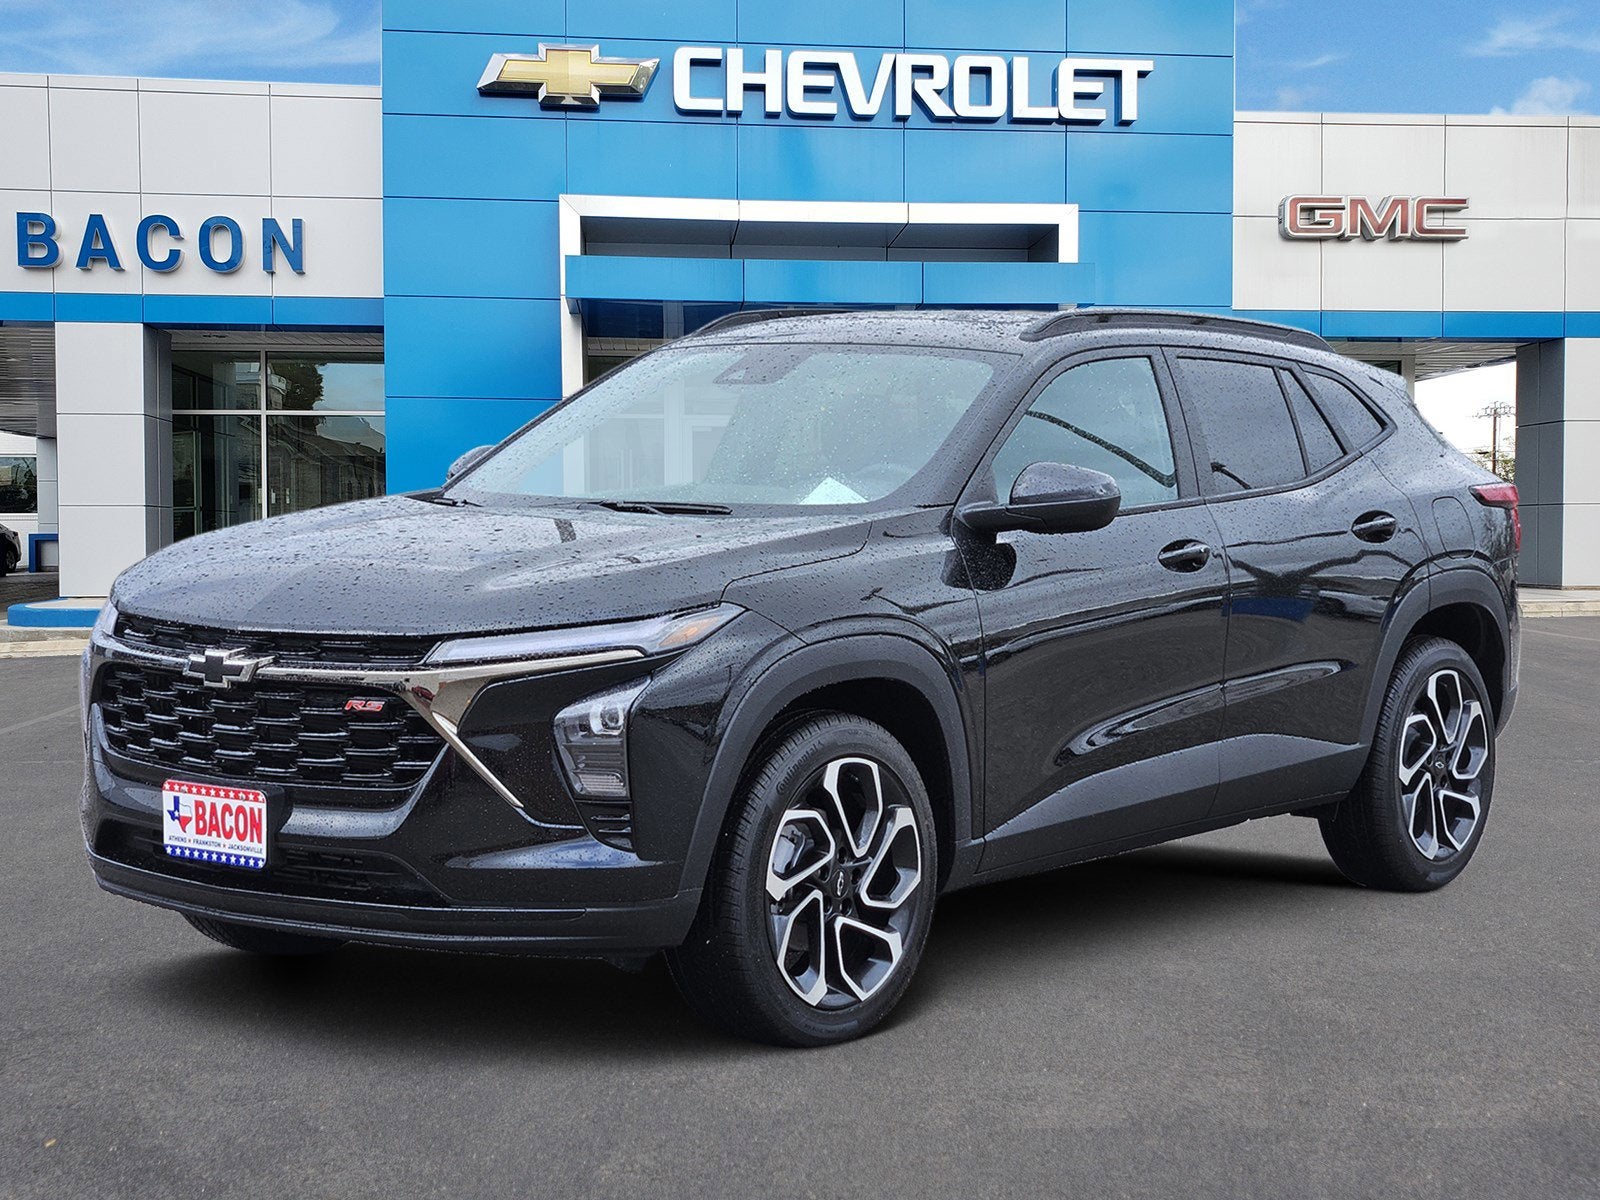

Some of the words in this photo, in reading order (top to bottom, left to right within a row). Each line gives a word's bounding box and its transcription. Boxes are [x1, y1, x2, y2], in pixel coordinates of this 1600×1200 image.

[672, 46, 1154, 122] CHEVROLET
[1280, 195, 1469, 241] GMC
[16, 211, 305, 274] BACON
[344, 699, 385, 711] RS
[194, 799, 263, 844] BACON
[168, 835, 187, 843] ATHENS
[192, 838, 221, 848] FRANKSTON
[227, 843, 263, 854] JACKSONVILLE
